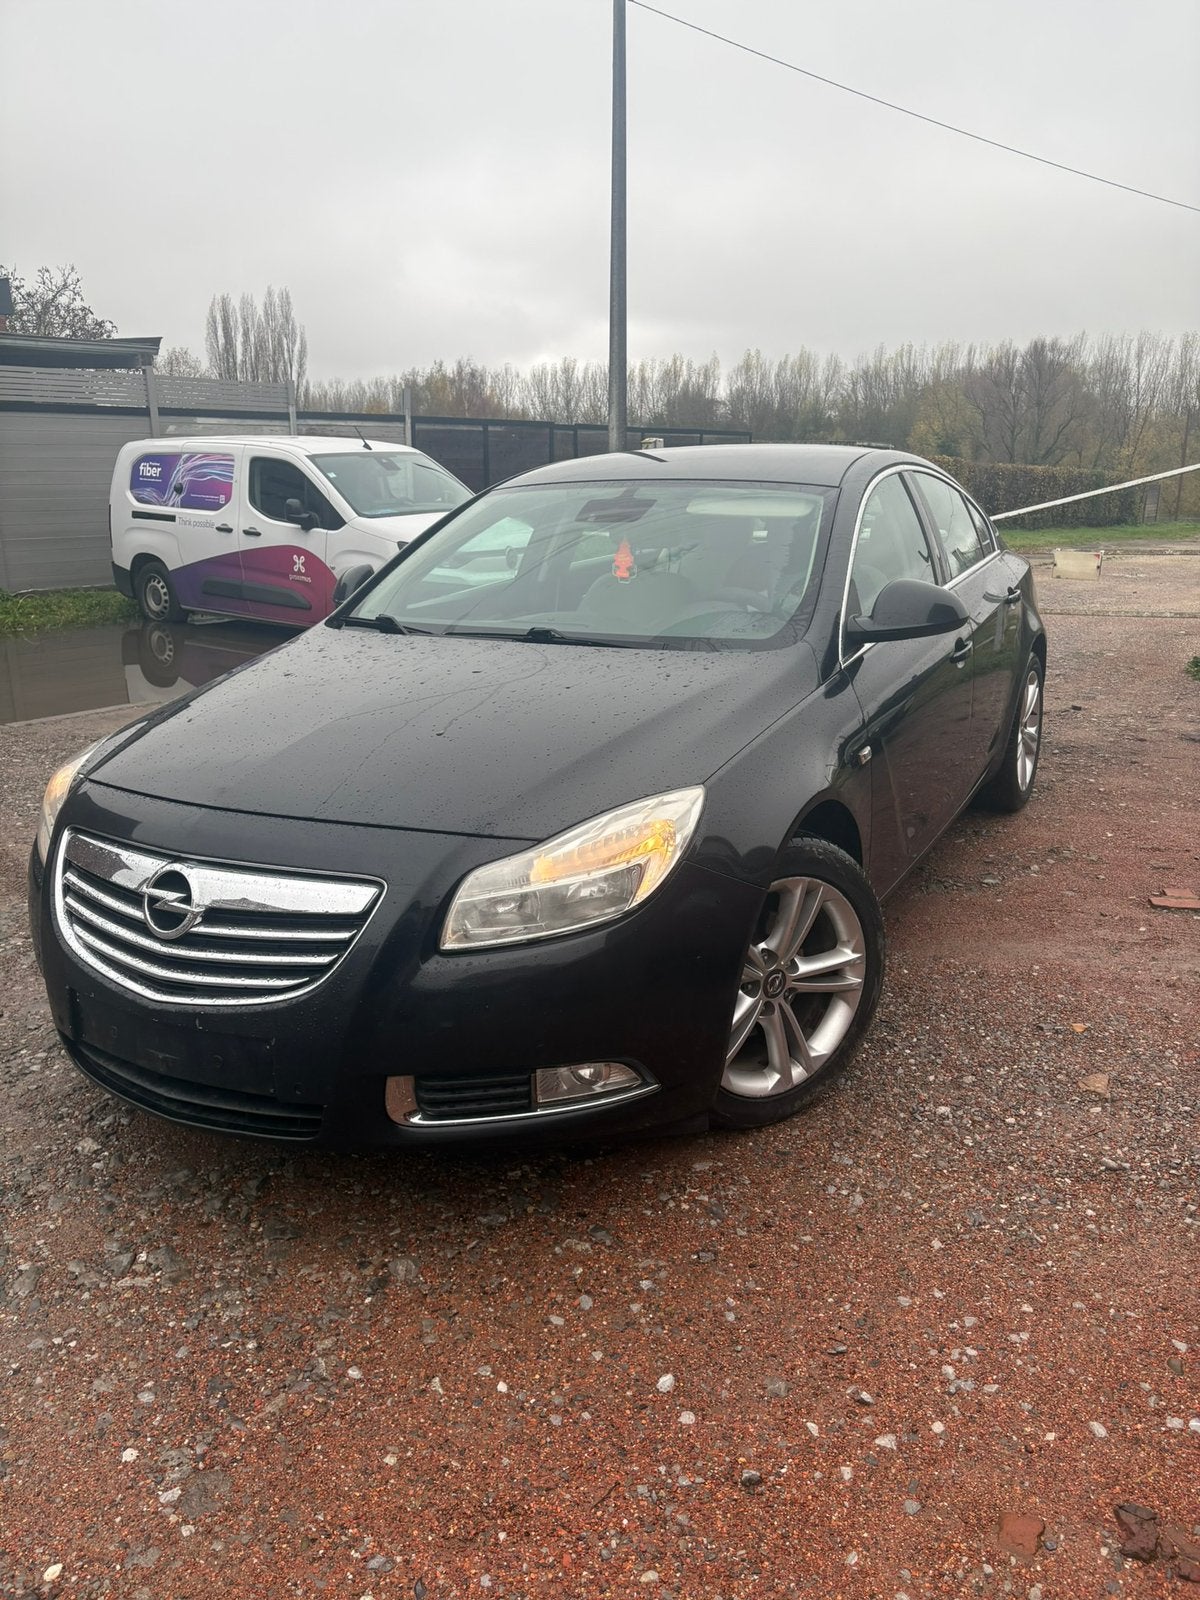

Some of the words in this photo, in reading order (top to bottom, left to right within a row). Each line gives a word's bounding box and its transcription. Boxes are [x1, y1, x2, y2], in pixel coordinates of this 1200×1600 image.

[139, 462, 162, 477] fiber
[178, 516, 192, 527] Think
[193, 519, 215, 529] possible
[289, 574, 311, 583] proximus
